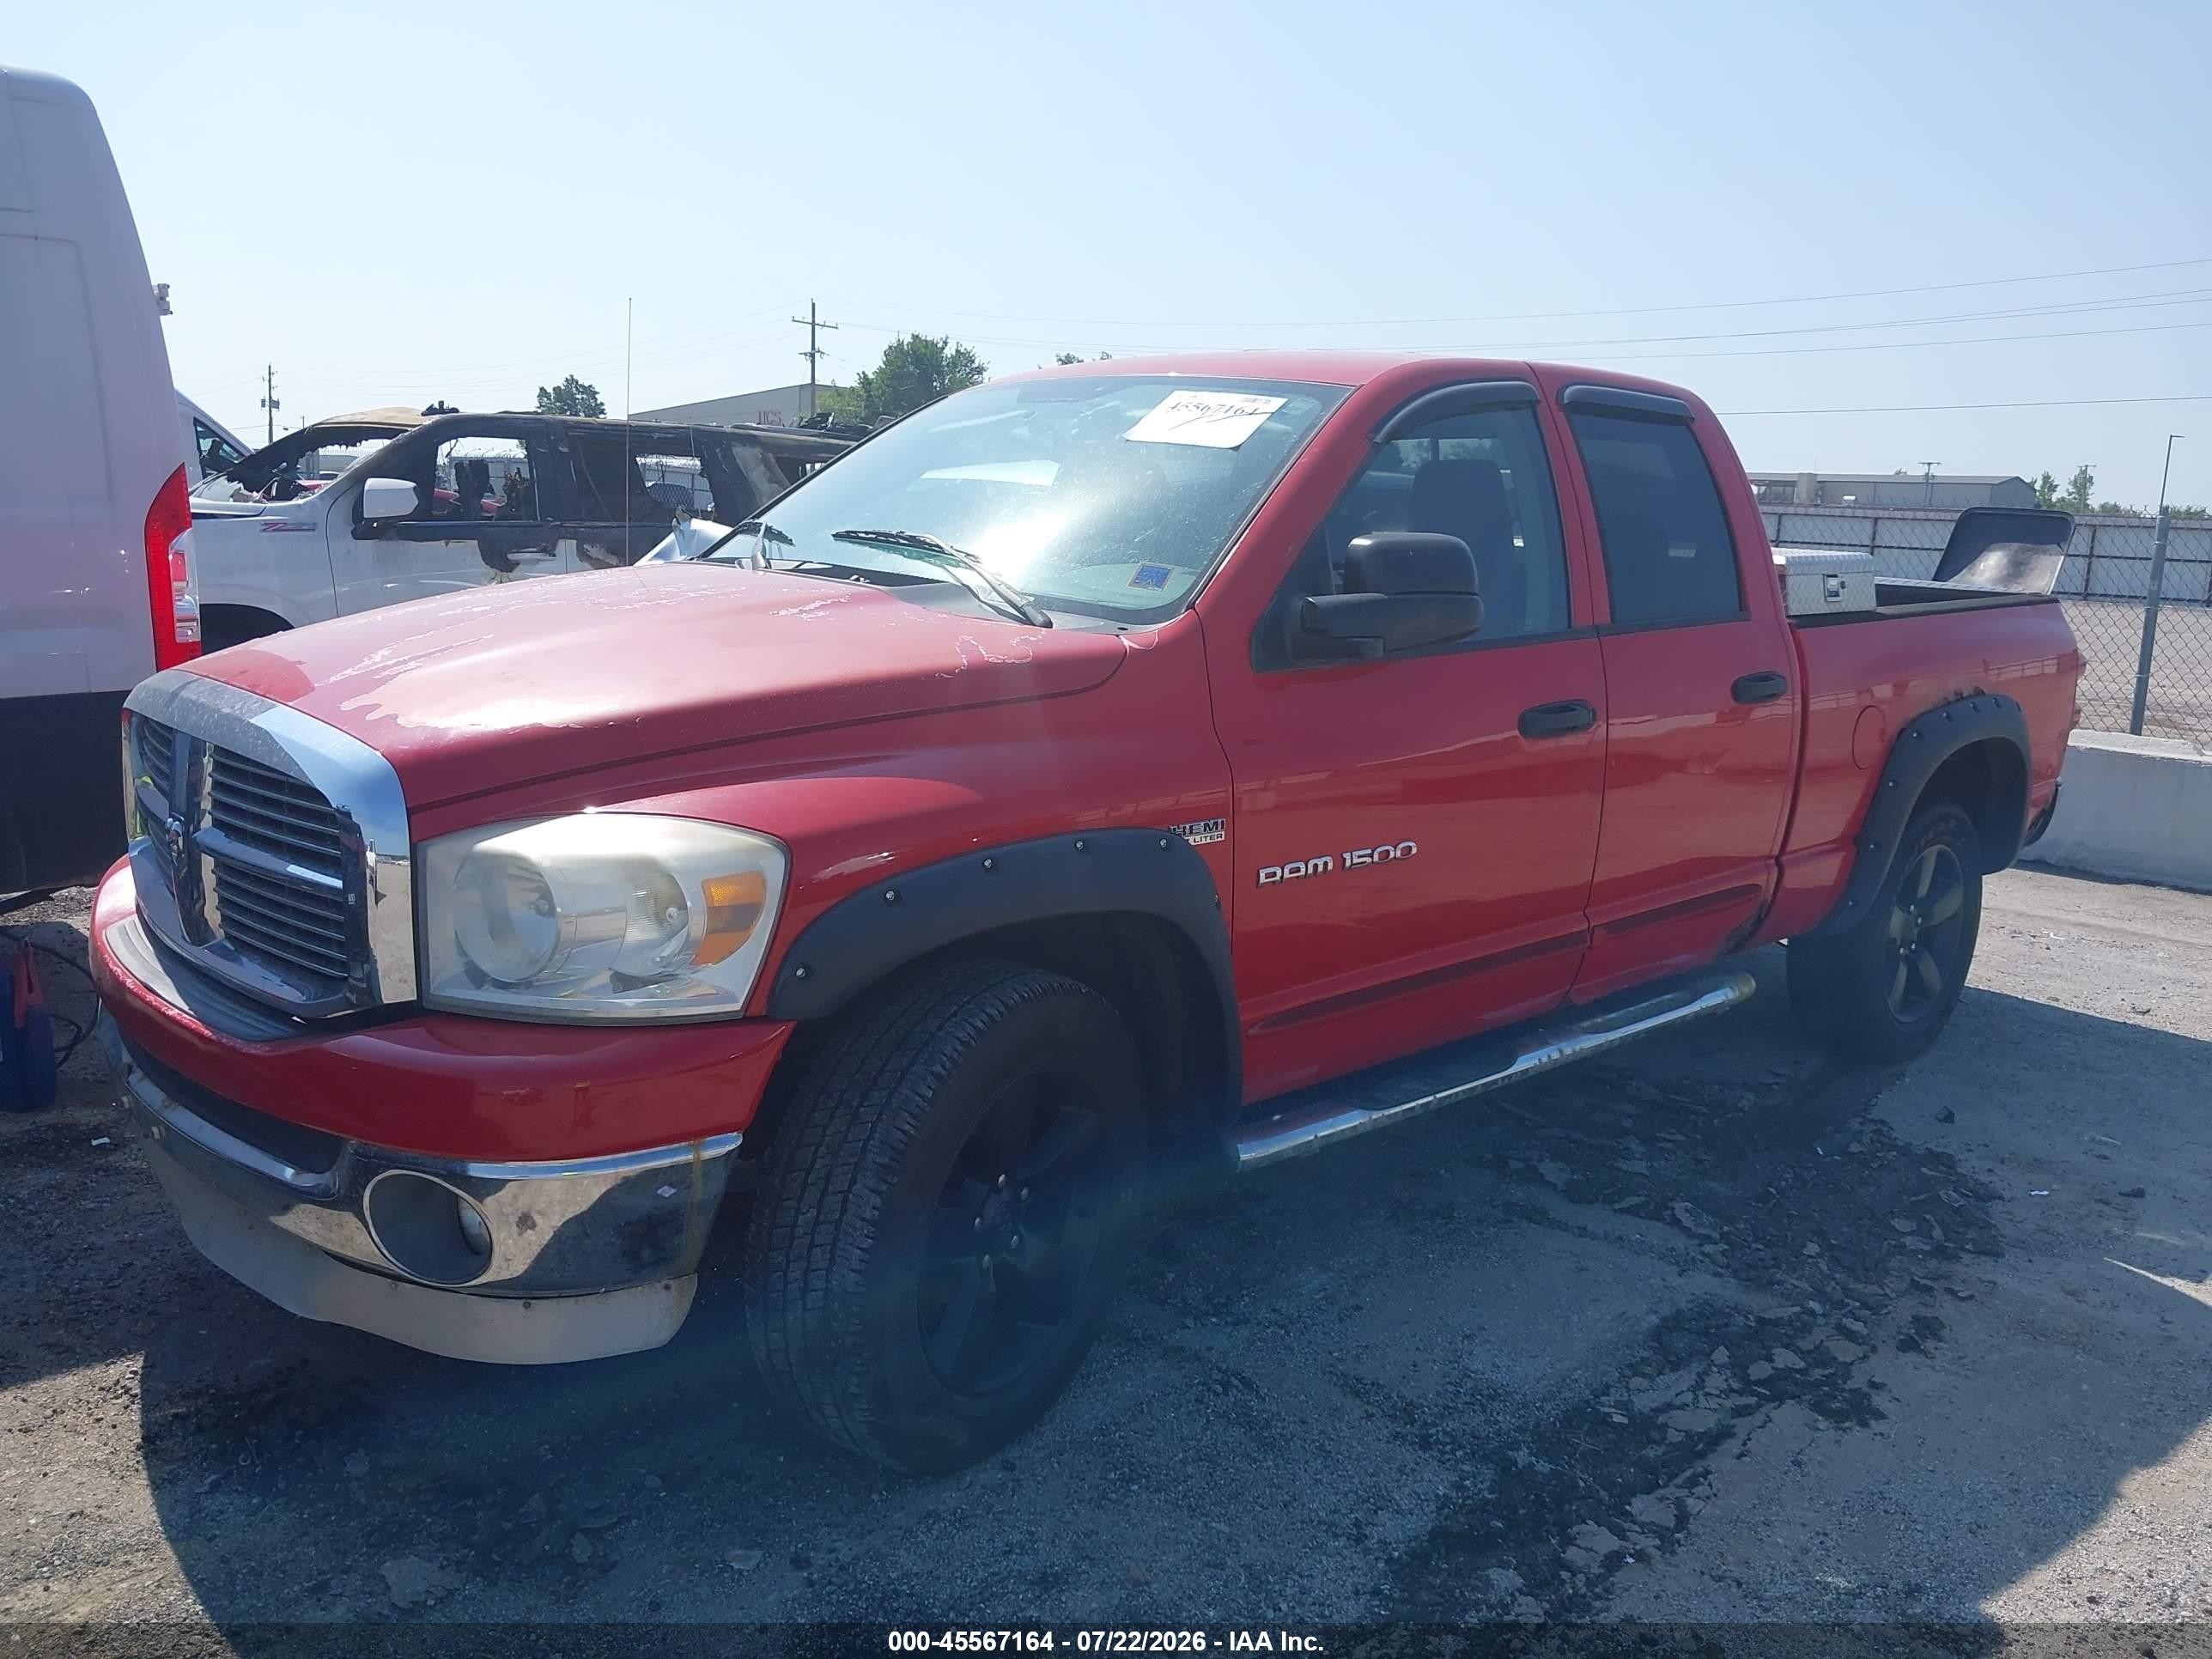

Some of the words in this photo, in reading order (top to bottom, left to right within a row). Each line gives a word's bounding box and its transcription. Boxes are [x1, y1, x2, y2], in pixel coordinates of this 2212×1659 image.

[1193, 833, 1223, 843] LITER
[1258, 856, 1334, 886] RAM
[1341, 840, 1418, 870] 1500
